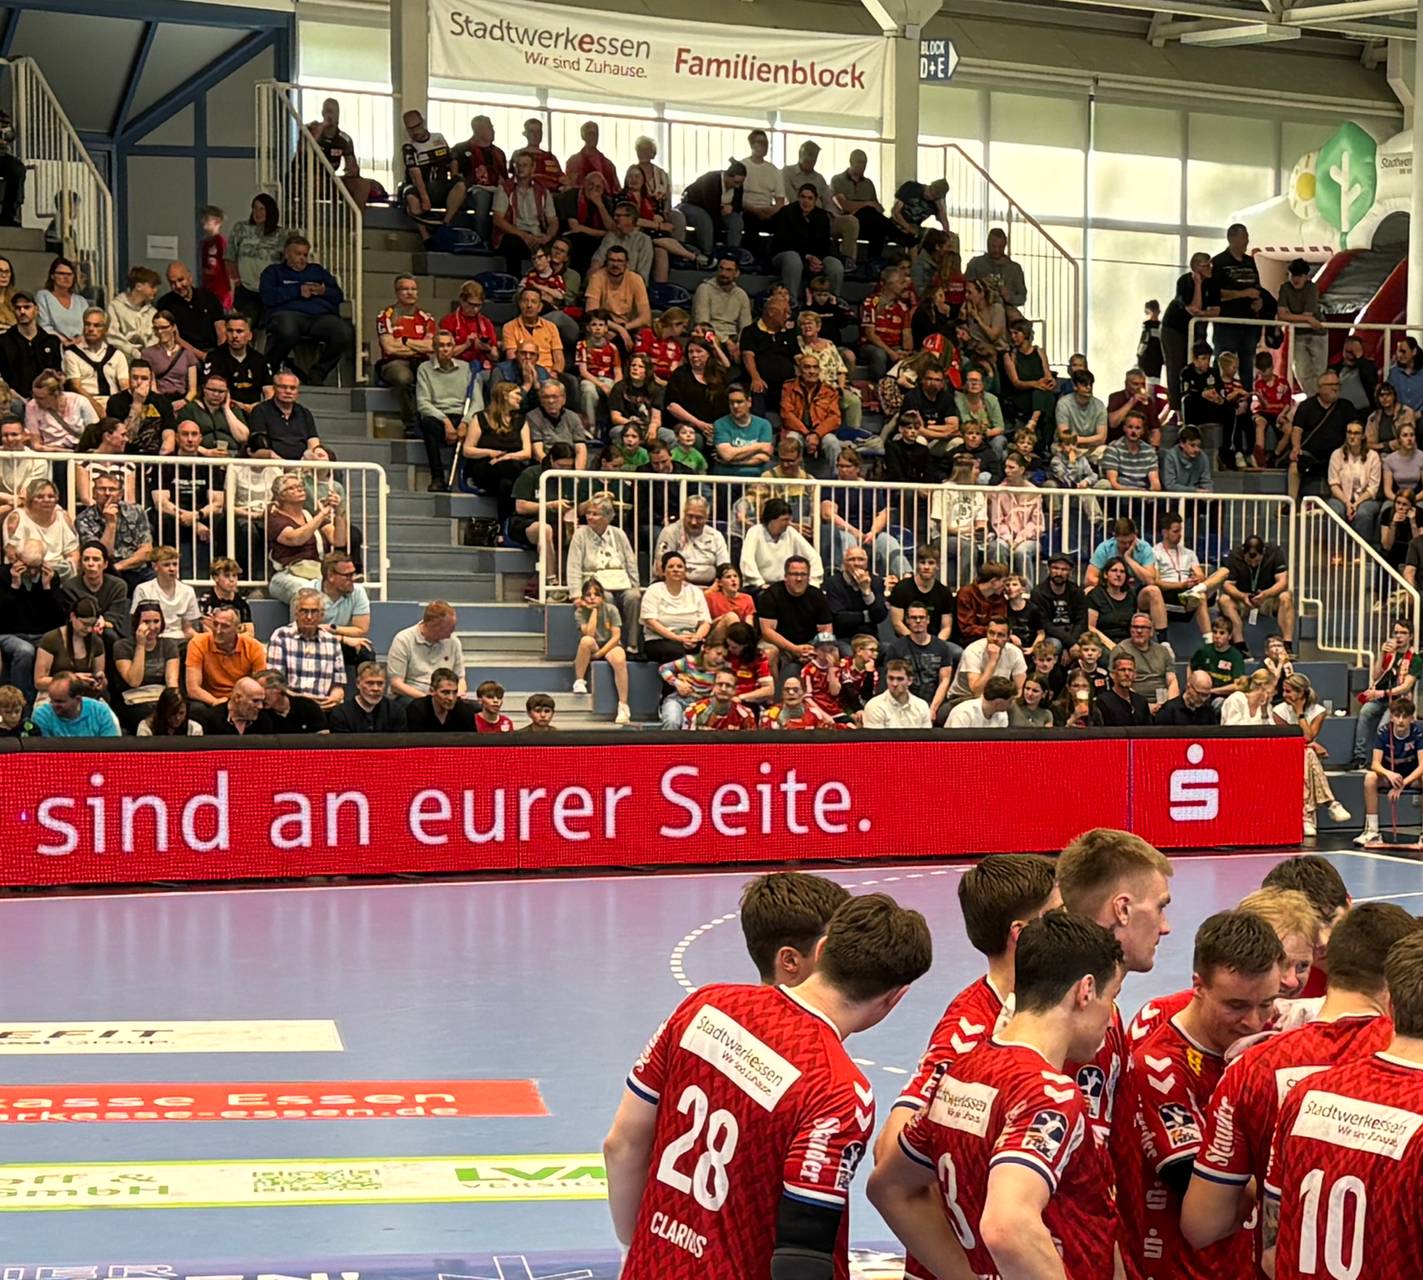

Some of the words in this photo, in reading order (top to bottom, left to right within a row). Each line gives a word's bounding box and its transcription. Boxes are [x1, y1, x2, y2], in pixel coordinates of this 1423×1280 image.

[450, 11, 650, 59] Stadtwerkessen
[675, 47, 865, 90] Familienblock
[525, 51, 549, 66] Wir
[553, 55, 581, 71] sind
[585, 58, 648, 78] Zuhause.
[920, 40, 946, 55] BLOCK
[920, 57, 946, 78] D+E
[35, 769, 230, 857] sind
[269, 789, 370, 852] an
[408, 784, 633, 846] eurer
[659, 762, 873, 839] Seite.
[696, 1015, 783, 1087] Stadtwerkessen
[0, 1096, 195, 1108] asse
[227, 1092, 456, 1106] Essen
[657, 1085, 739, 1212] 28
[650, 1211, 708, 1259] CLARIUS
[1299, 1169, 1367, 1280] 10
